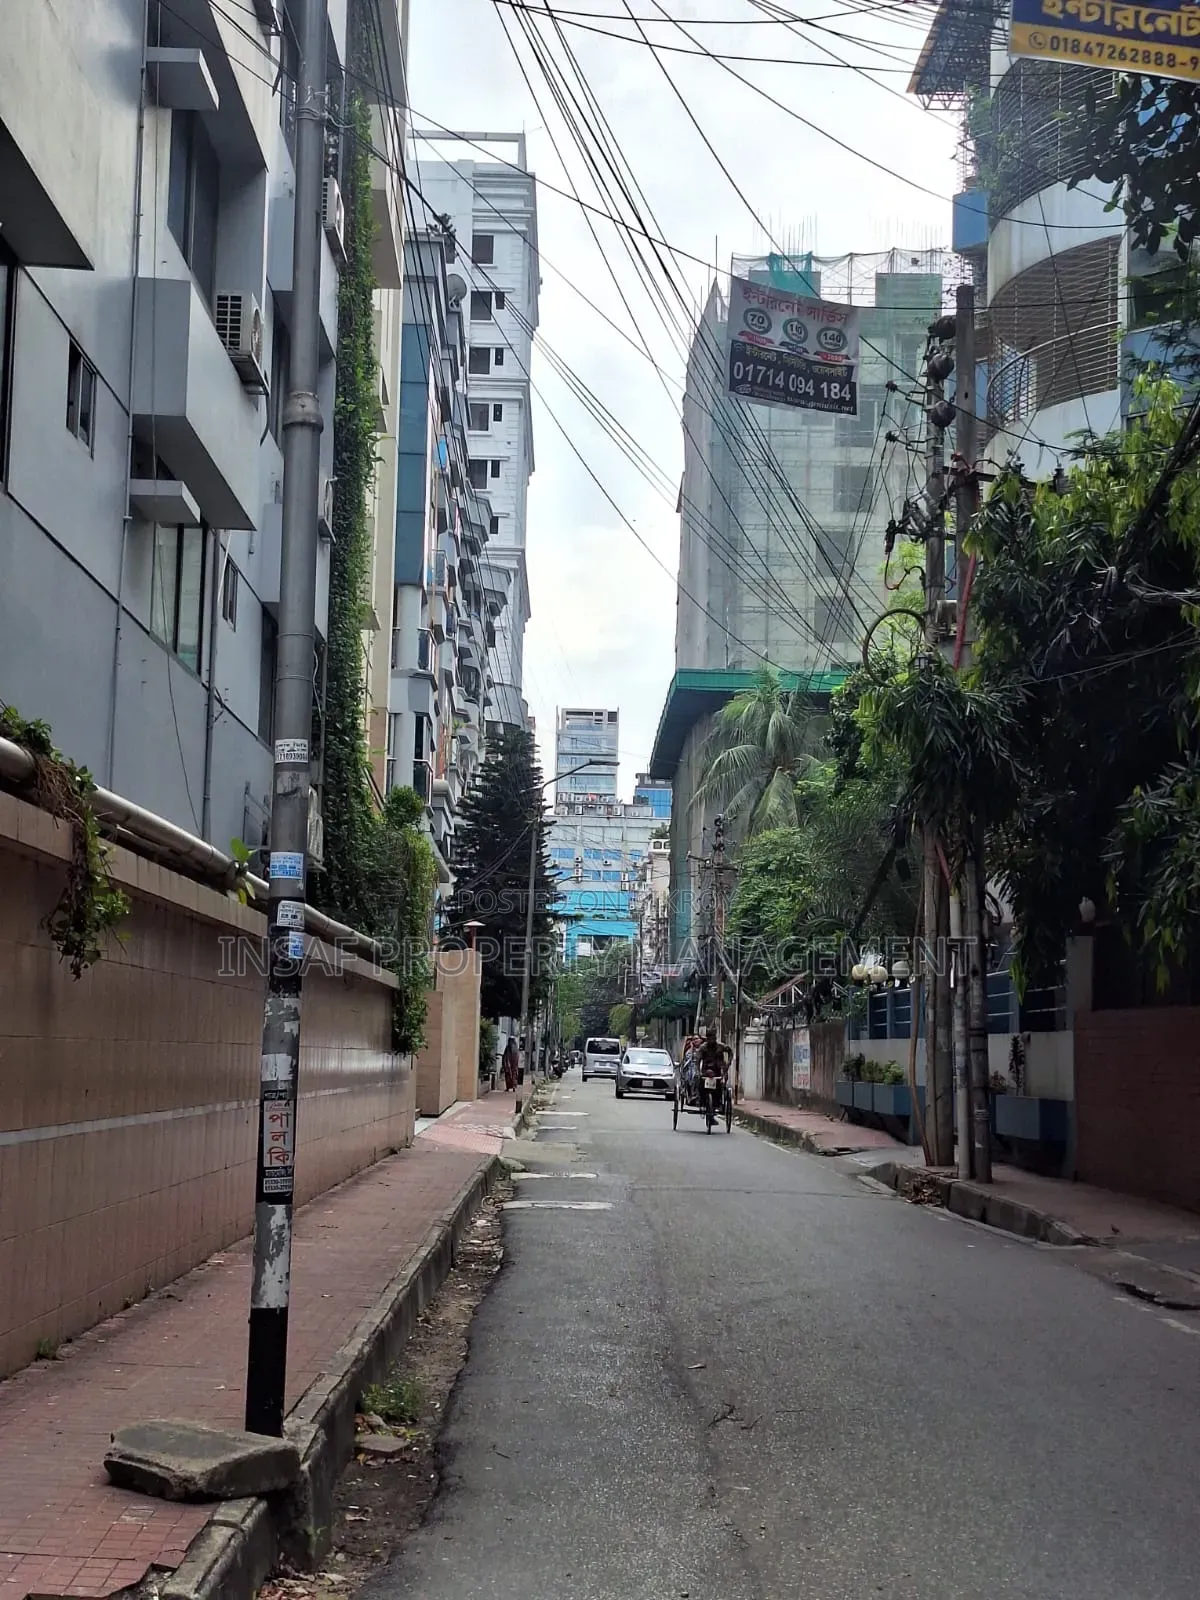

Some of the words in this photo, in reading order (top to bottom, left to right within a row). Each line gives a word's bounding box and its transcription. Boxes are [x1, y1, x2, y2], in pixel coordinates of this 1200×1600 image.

[1050, 35, 1200, 71] 01847262888-9
[750, 314, 765, 325] 70
[822, 331, 842, 343] 140
[734, 362, 784, 388] 01714
[788, 373, 815, 396] 094
[820, 382, 851, 401] 184
